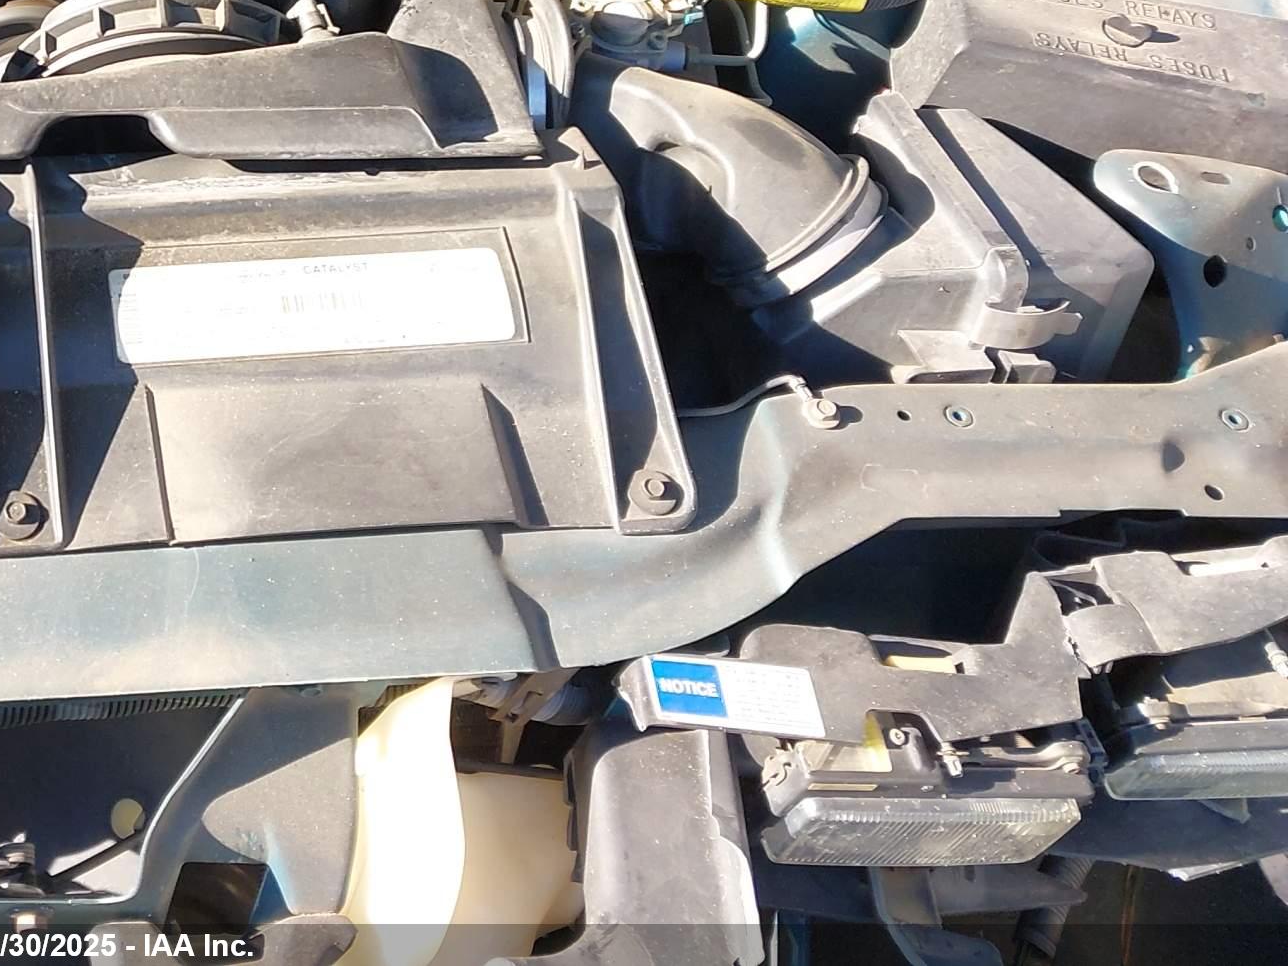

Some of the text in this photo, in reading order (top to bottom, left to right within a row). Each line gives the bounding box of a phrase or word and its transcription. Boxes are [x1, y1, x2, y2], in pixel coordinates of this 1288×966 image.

[1124, 0, 1217, 30] RELAYS
[1033, 31, 1231, 83] FUSES RELAYS
[303, 261, 370, 275] CATALYST
[659, 677, 721, 698] NOTICE
